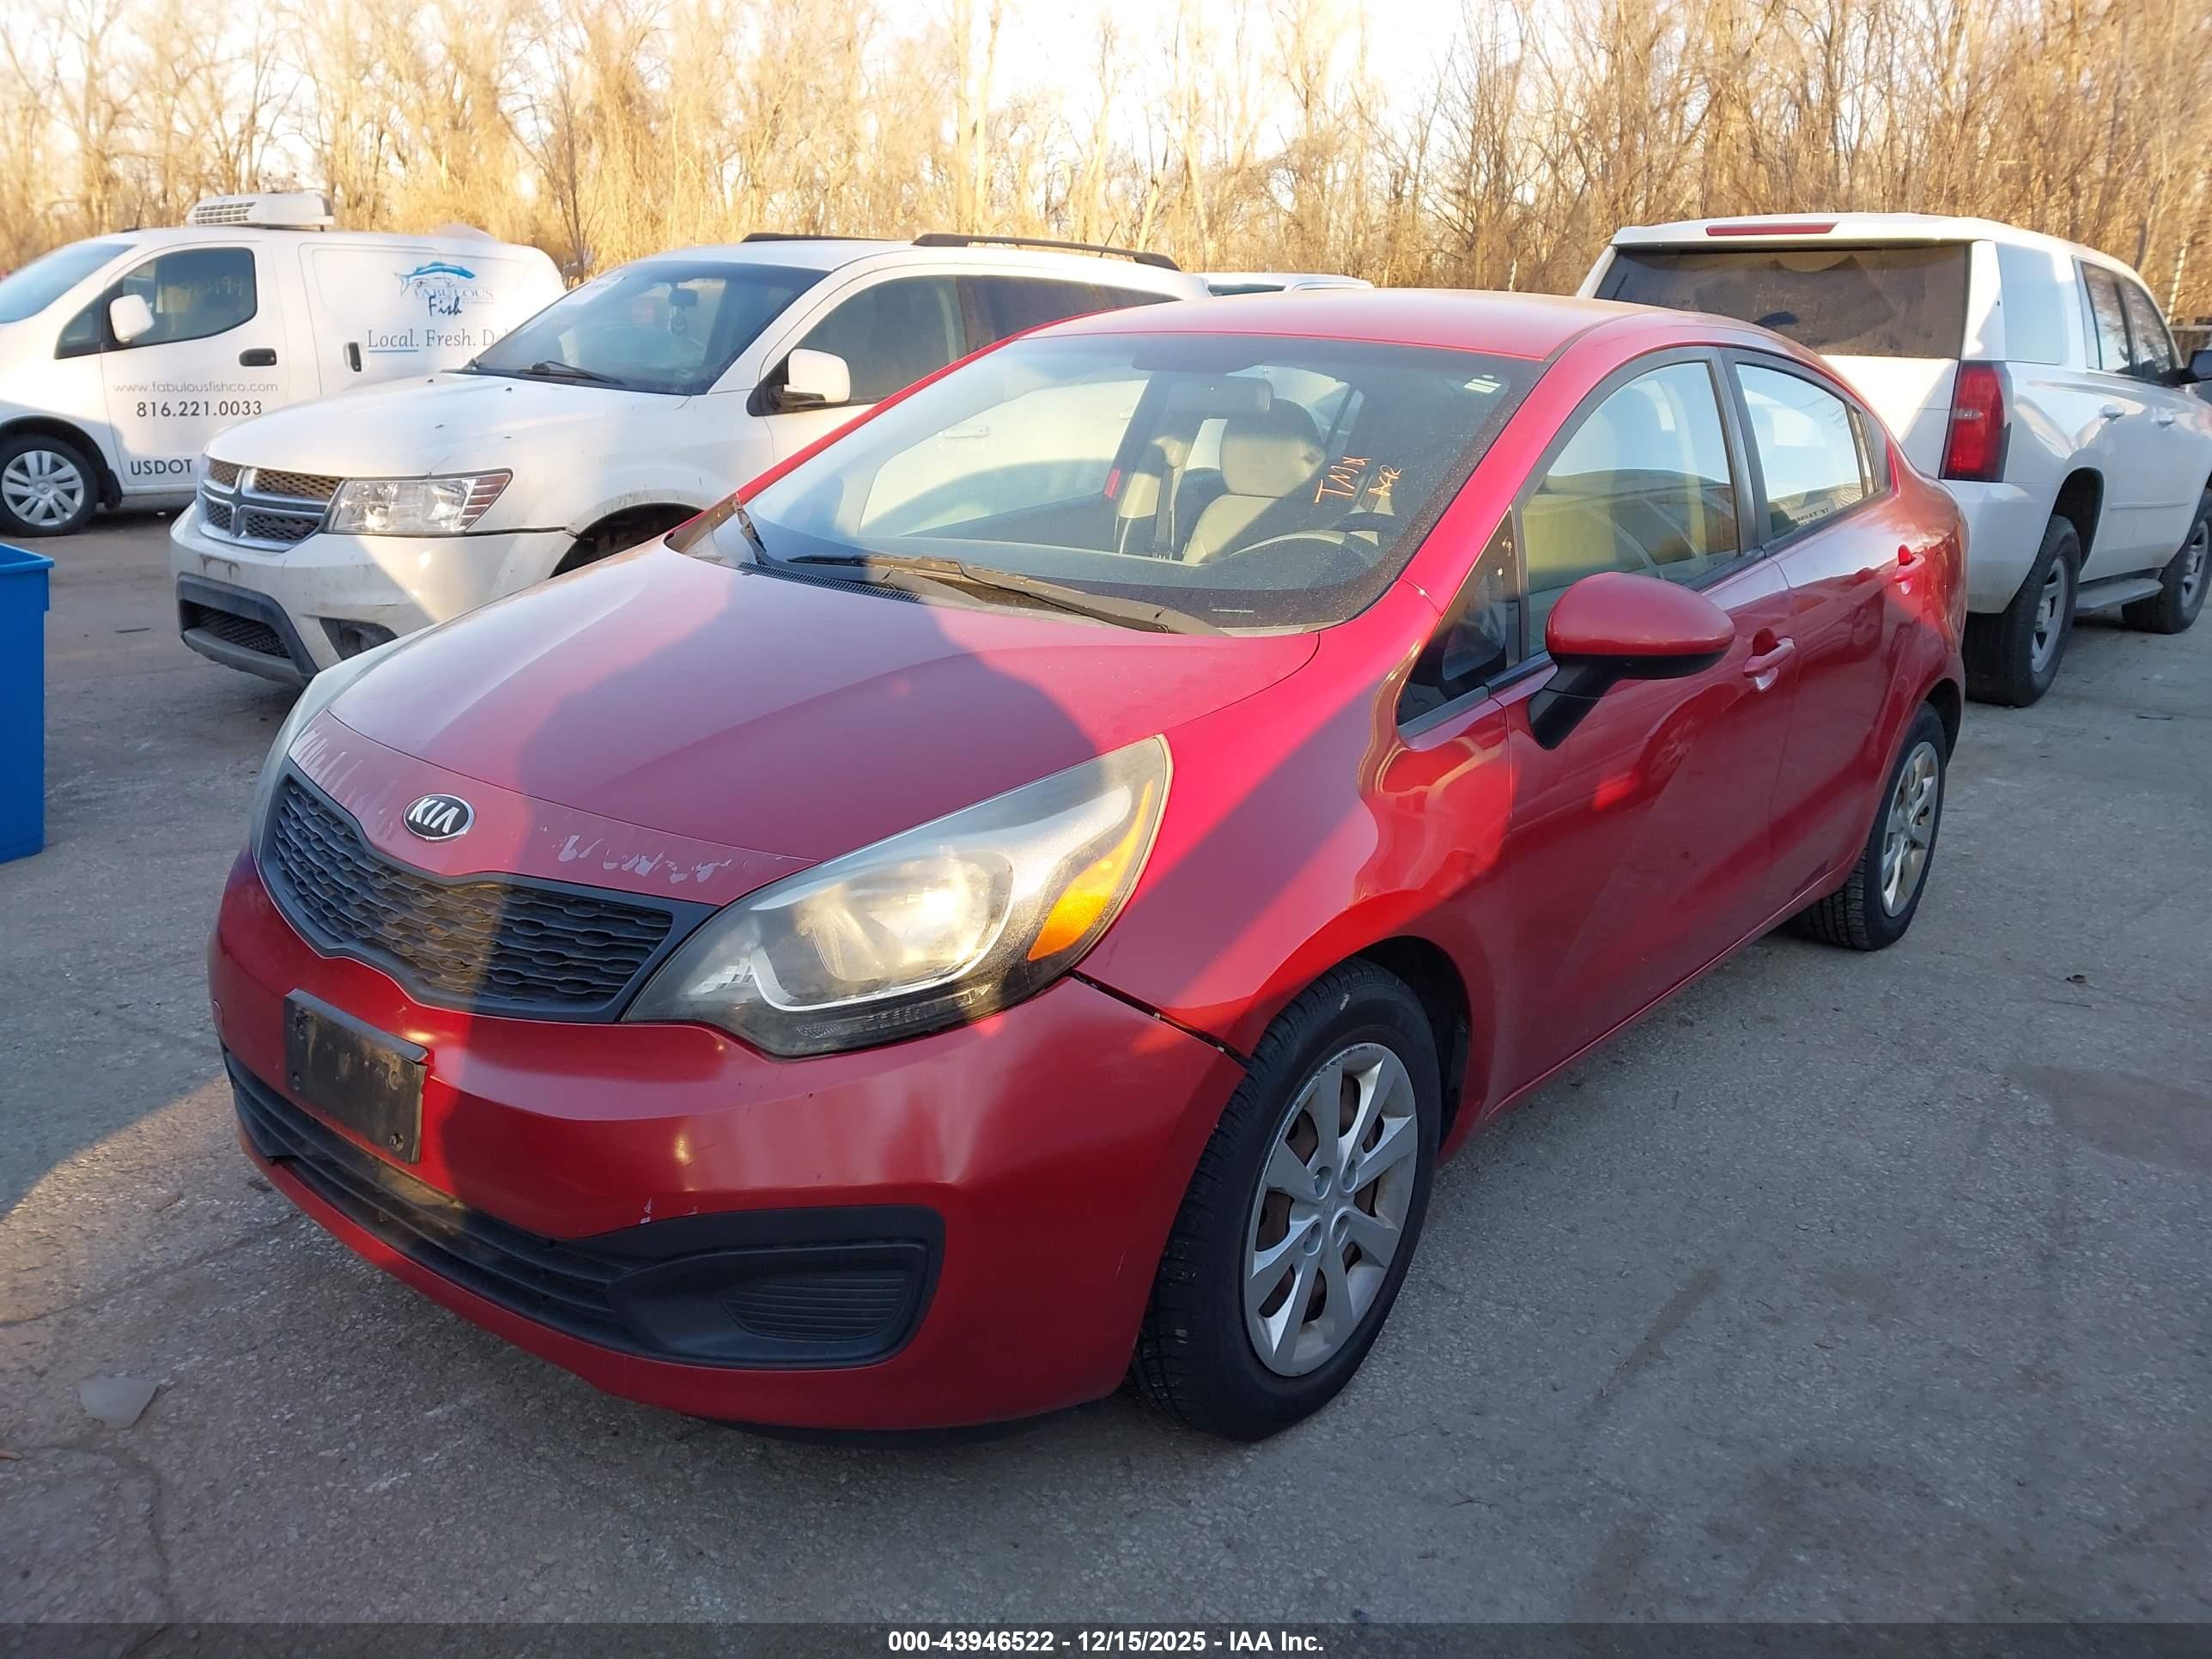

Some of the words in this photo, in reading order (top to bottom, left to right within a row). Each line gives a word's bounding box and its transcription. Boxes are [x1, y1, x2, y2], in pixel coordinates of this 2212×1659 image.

[428, 295, 463, 317] Fish
[368, 328, 420, 348] Local.
[426, 328, 477, 347] Fresh.
[113, 380, 279, 393] www.fabulousfishco.com
[137, 400, 263, 417] 816.221.0033
[130, 459, 193, 476] USDOT
[408, 797, 460, 835] KIA
